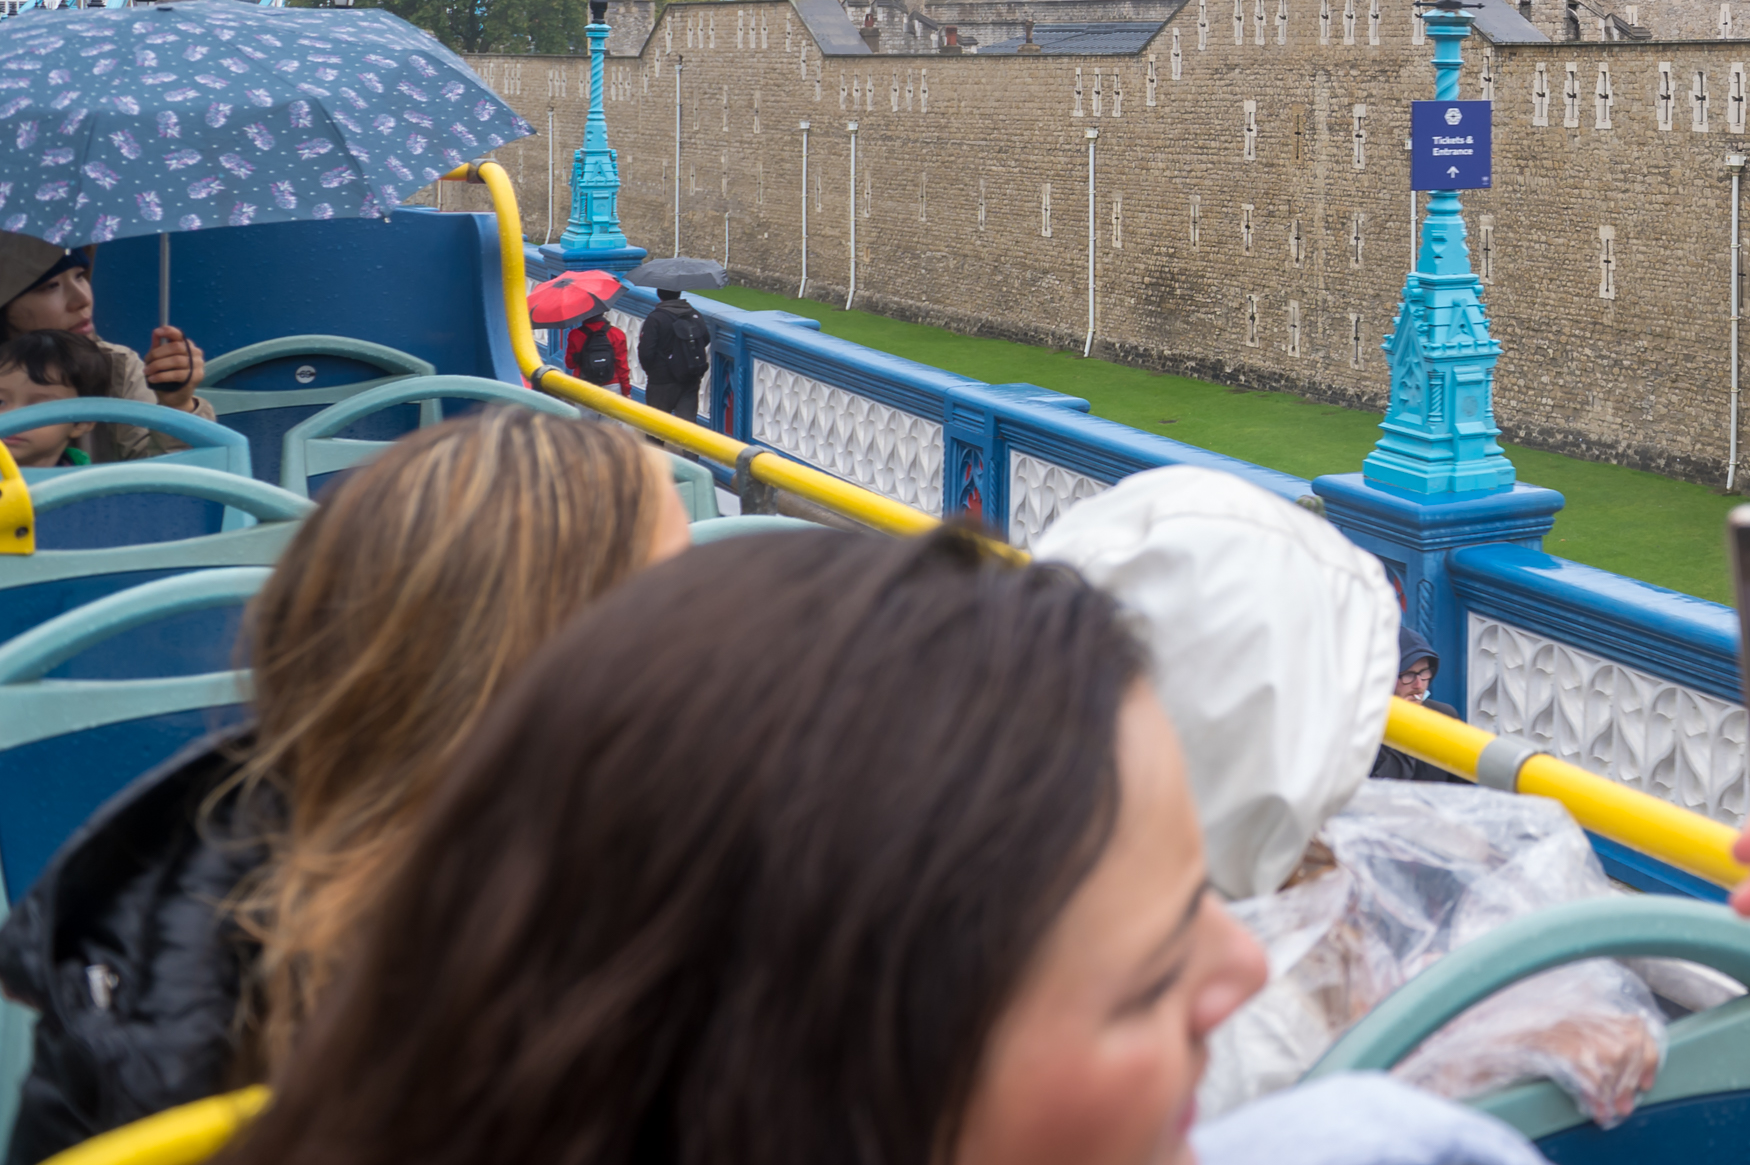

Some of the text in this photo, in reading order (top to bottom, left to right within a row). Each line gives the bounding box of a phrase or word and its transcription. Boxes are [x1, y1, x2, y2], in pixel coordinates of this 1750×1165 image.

[1432, 135, 1474, 145] Tickets &
[1432, 147, 1474, 156] Entrance
